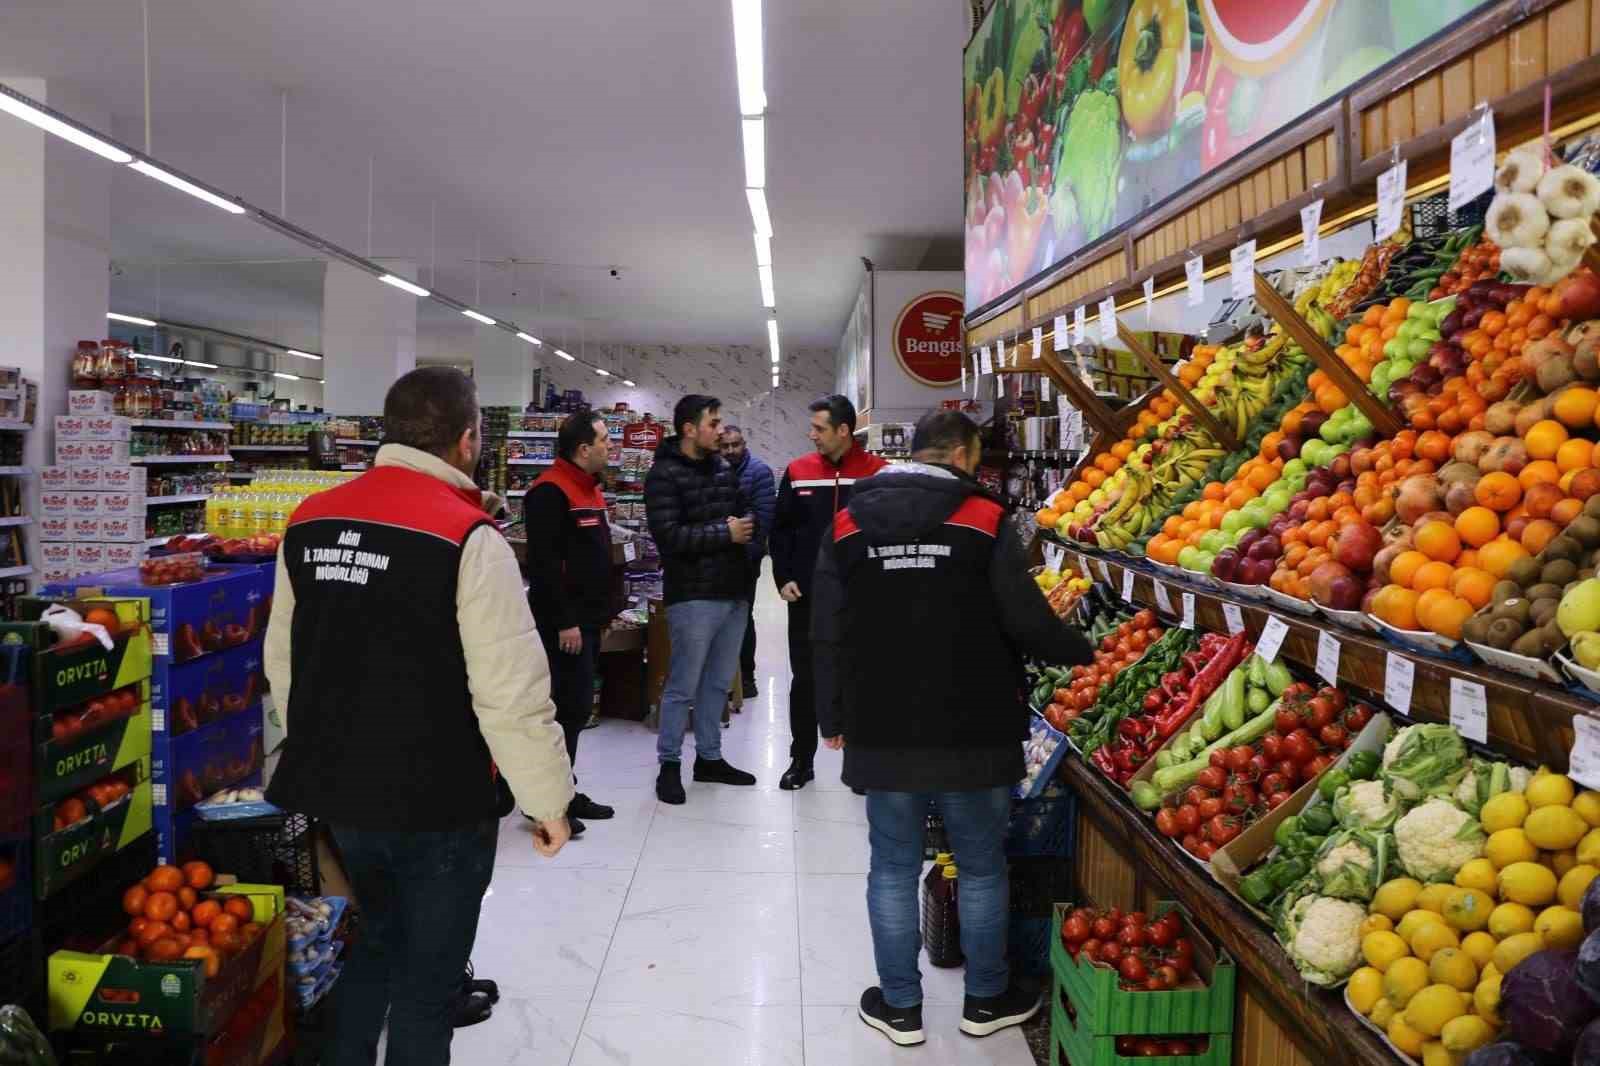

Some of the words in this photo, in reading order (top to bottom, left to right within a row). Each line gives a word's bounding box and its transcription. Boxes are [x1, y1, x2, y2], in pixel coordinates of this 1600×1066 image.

[313, 548, 341, 562] TARIM
[341, 549, 354, 563] VE
[354, 551, 390, 570] ORMAN
[57, 658, 107, 686] ORVITA
[56, 743, 107, 776] ORVITA
[83, 1011, 163, 1028] ORVITA
